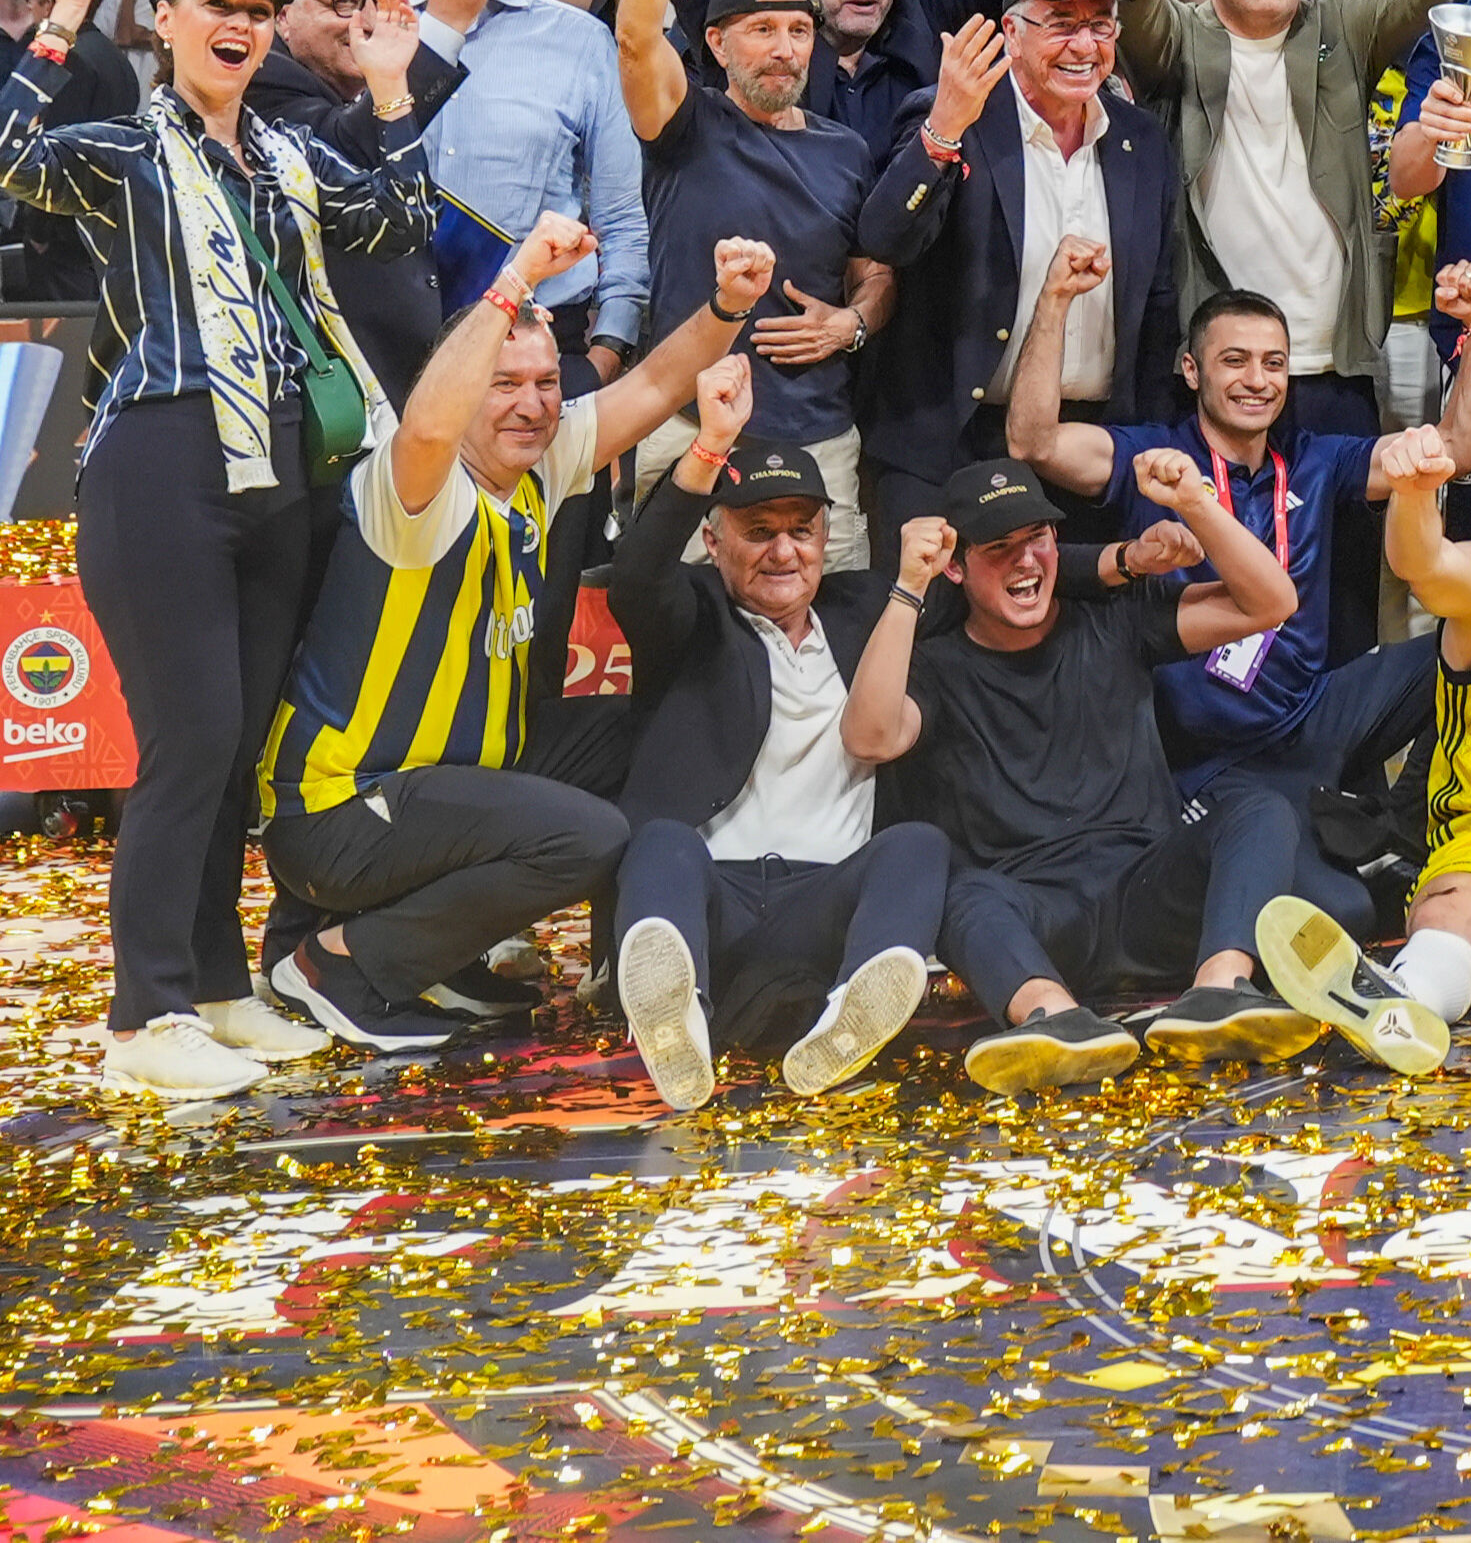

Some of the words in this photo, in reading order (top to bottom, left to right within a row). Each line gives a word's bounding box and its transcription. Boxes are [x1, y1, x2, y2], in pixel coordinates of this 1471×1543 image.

[750, 468, 801, 481] CHAMPIONS
[979, 485, 1028, 504] CHAMPIONS
[45, 629, 77, 647] SPOR
[32, 696, 58, 706] 1907
[3, 716, 87, 746] beko
